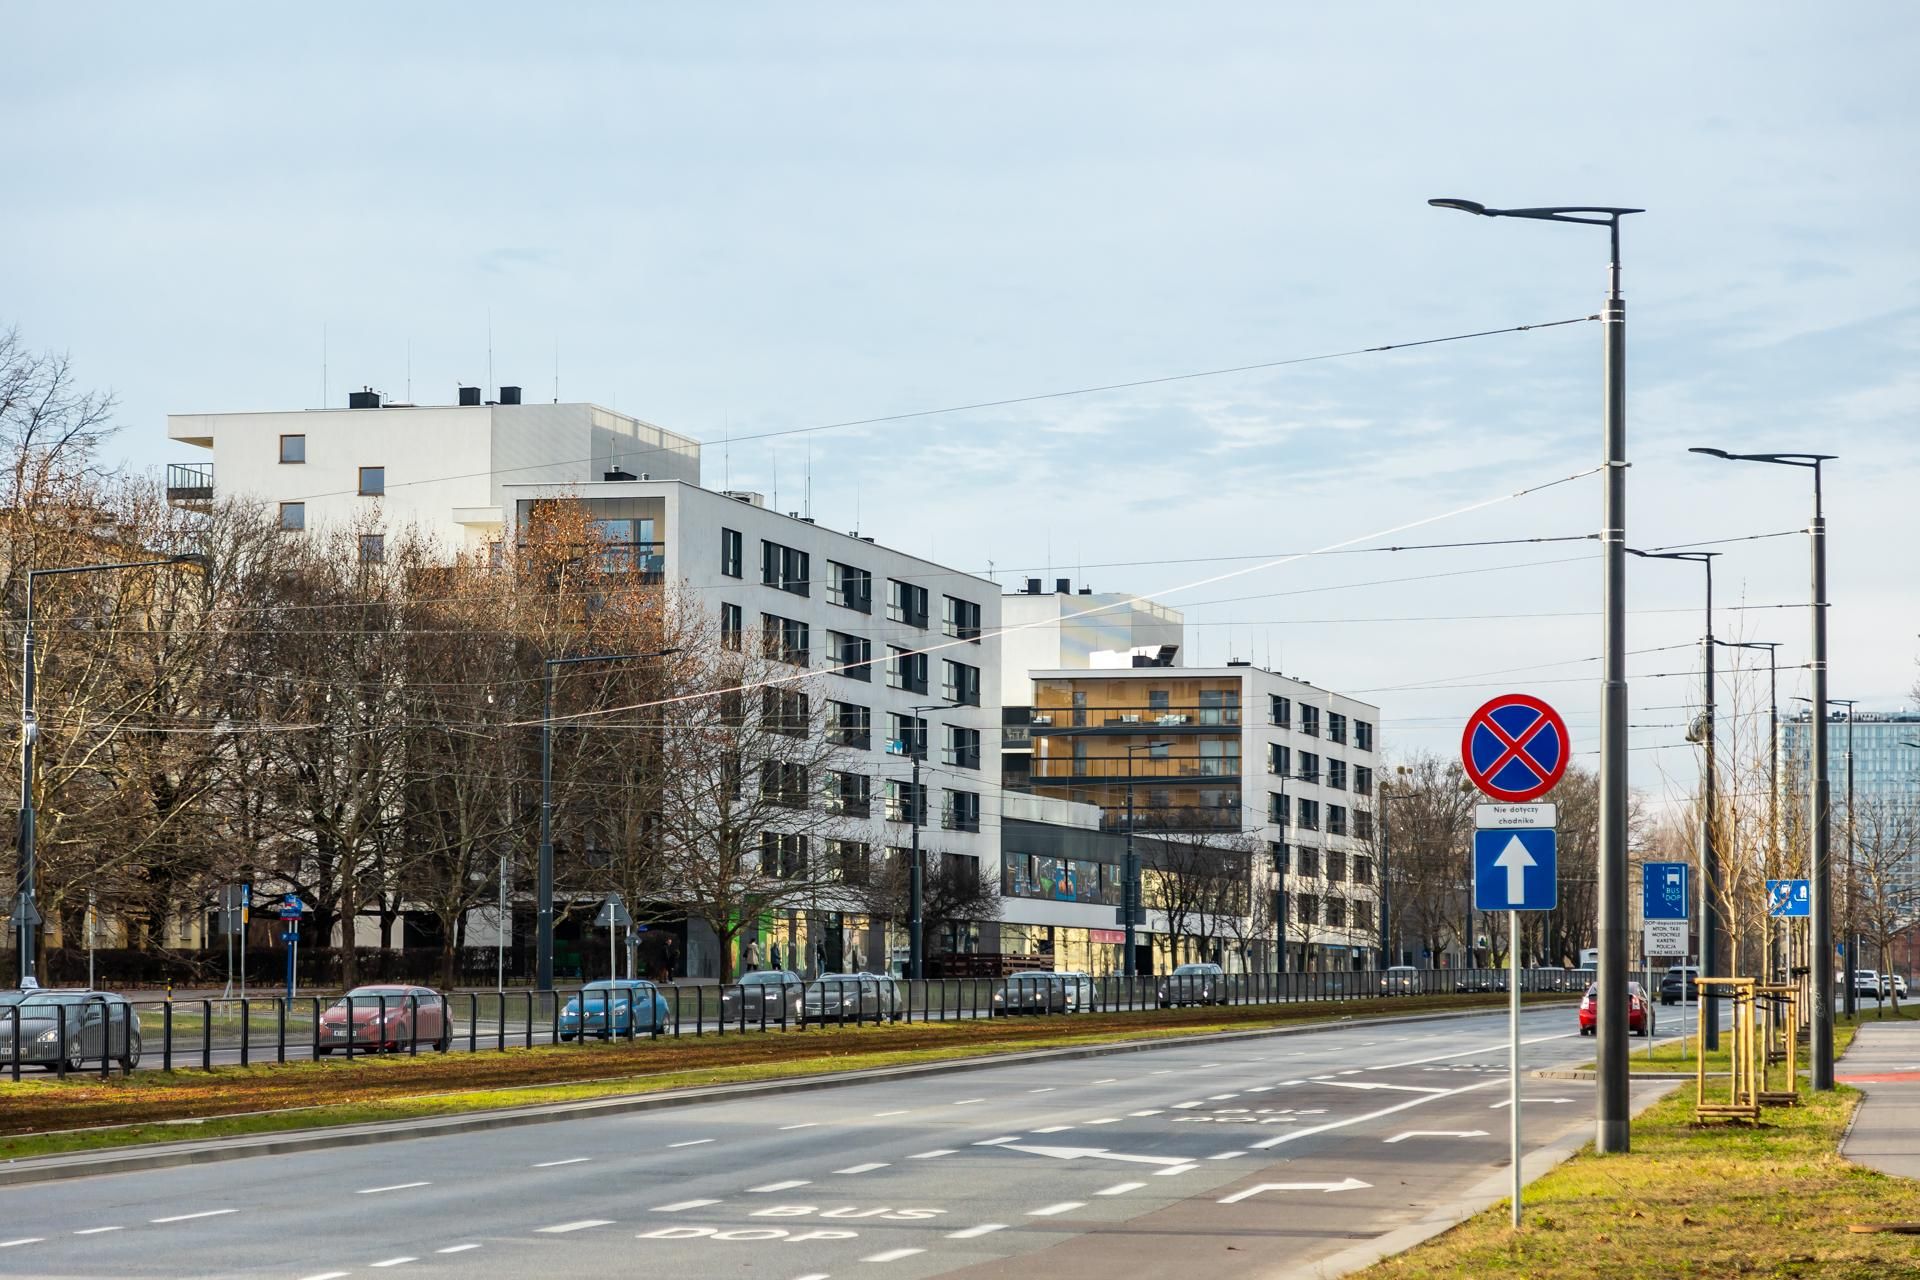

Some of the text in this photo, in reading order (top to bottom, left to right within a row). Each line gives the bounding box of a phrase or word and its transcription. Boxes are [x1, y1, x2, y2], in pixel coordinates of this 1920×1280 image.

[1510, 806, 1539, 814] dotyczy
[749, 1205, 949, 1219] BUS
[635, 1227, 859, 1242] DOP
